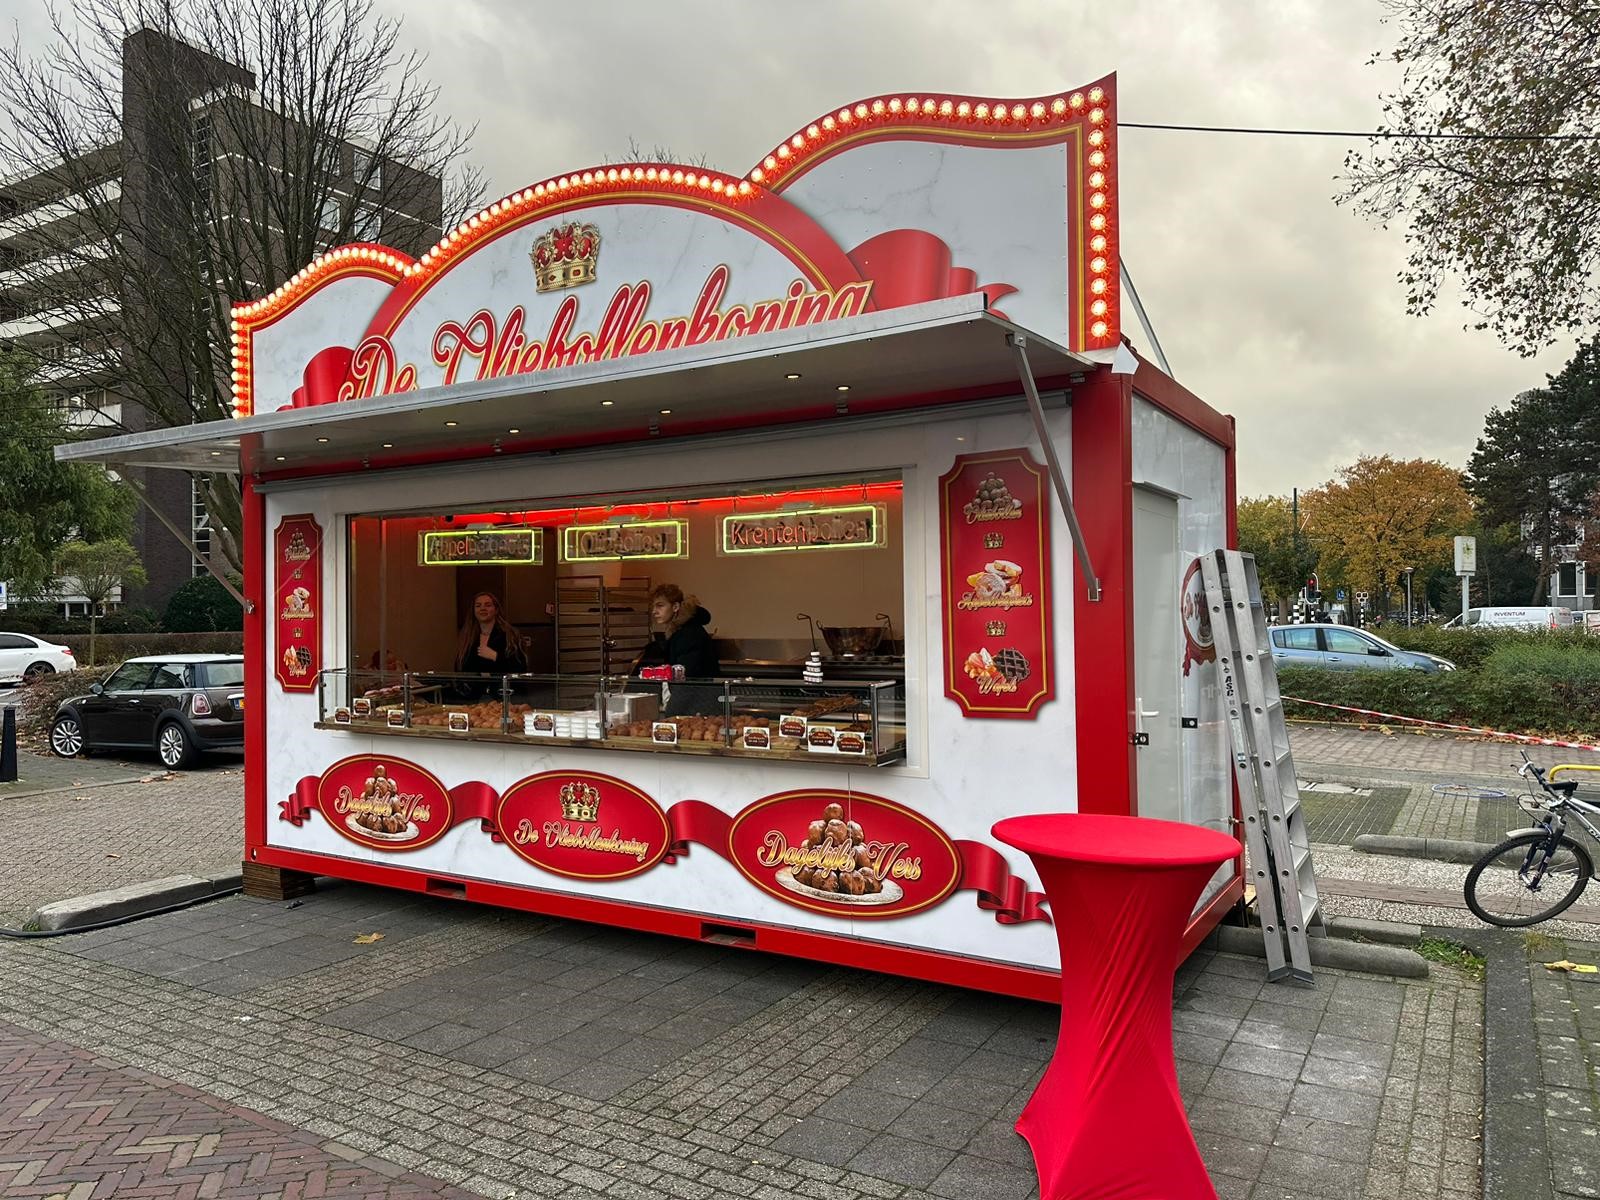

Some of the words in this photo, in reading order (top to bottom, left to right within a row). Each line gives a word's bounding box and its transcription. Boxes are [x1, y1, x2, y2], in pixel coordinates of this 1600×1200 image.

[580, 529, 669, 556] Oliollen
[1225, 675, 1234, 697] ASC
[399, 793, 431, 823] Vers
[513, 818, 540, 845] De
[757, 830, 856, 878] Dagelijks
[867, 841, 923, 881] Vers
